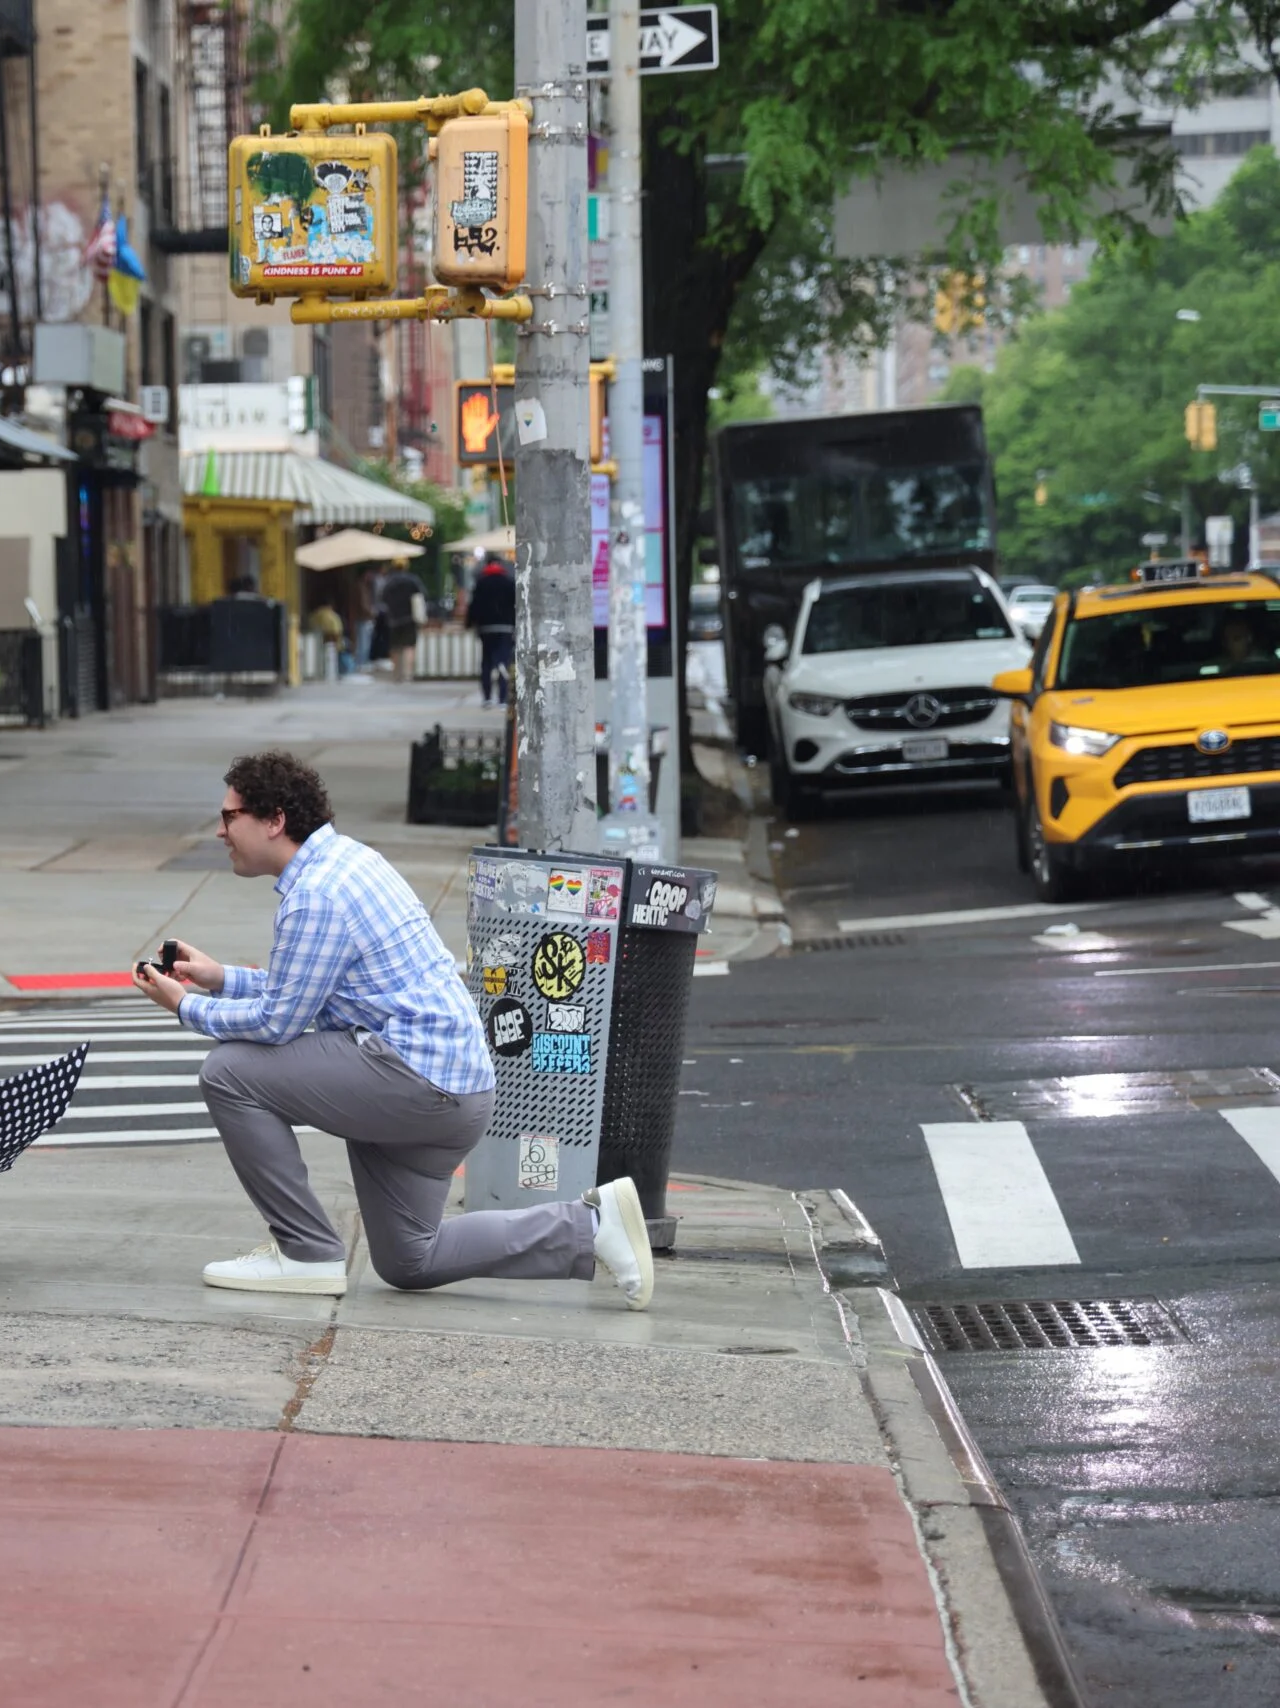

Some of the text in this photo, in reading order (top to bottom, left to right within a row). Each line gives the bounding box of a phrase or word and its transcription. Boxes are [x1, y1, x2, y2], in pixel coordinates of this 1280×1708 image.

[264, 265, 363, 276] KINDNESS IS PUNK AF
[650, 881, 687, 912] COOP
[632, 904, 669, 927] HEKTIC
[533, 1034, 591, 1055] DISCOUNT
[532, 1054, 591, 1073] BEEPERS
